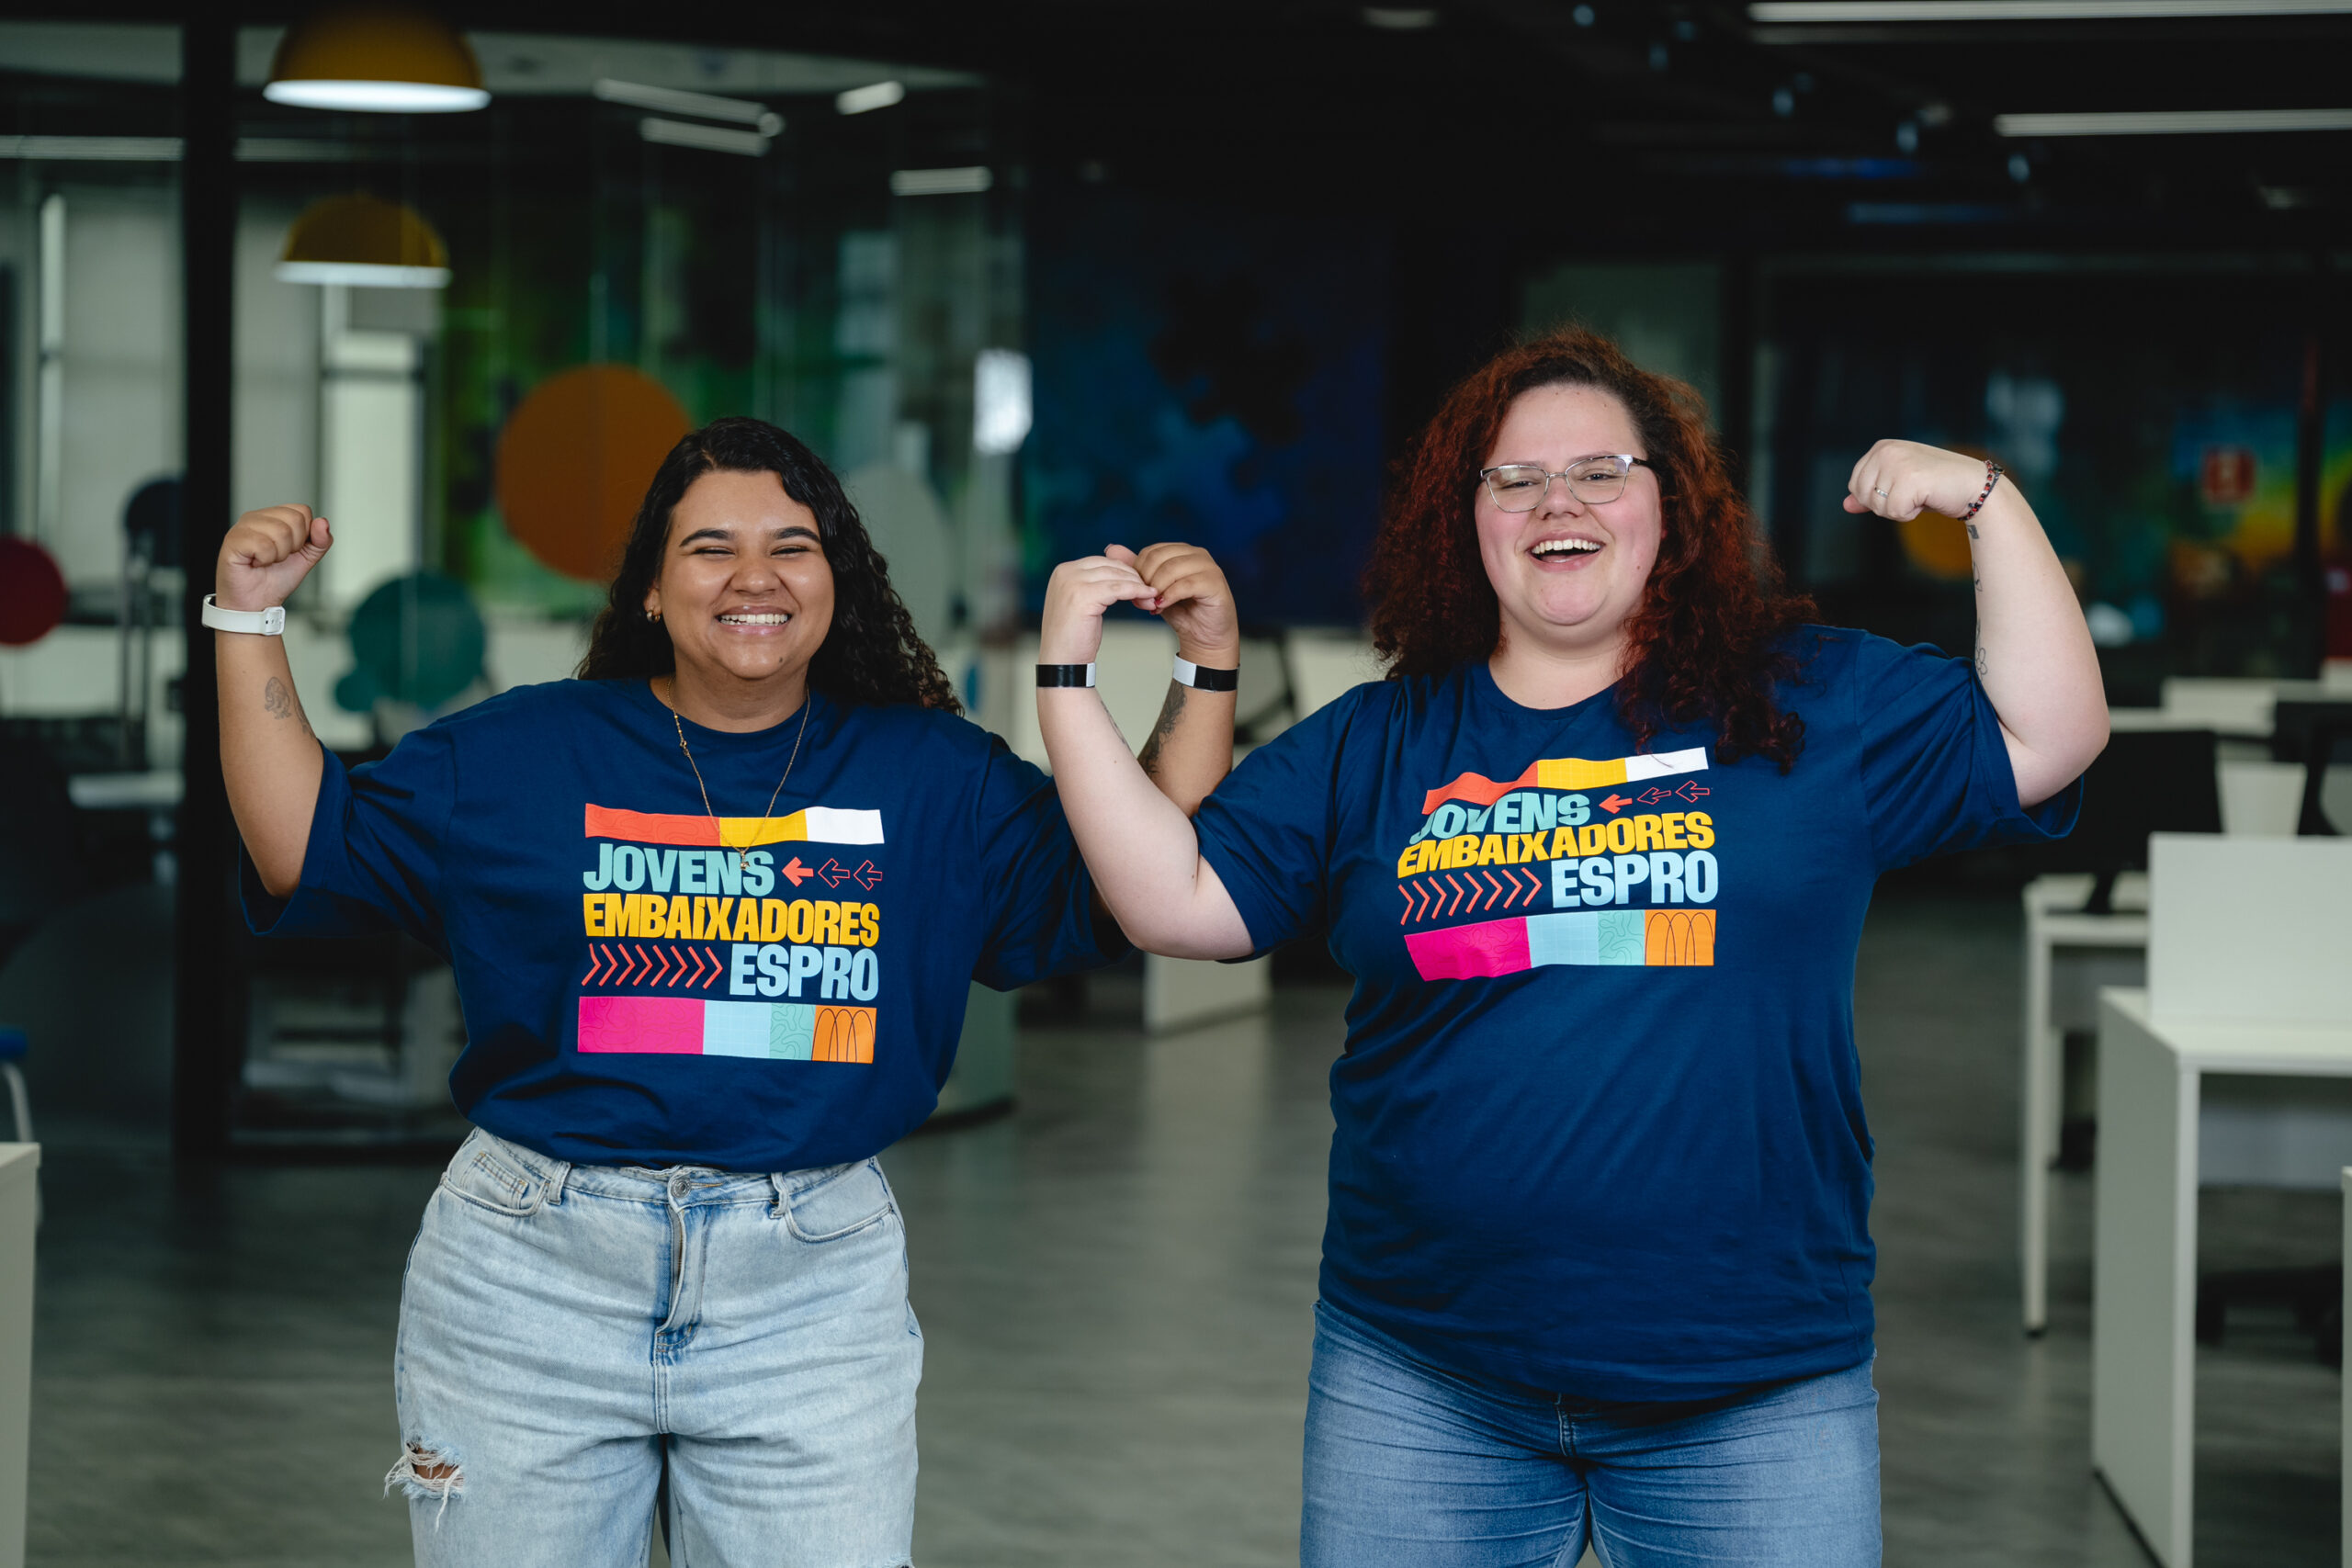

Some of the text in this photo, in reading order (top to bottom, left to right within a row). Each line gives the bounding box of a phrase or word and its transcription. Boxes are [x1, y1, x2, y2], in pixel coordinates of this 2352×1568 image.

[1397, 811, 1715, 878] EMBAIXADORES
[1408, 792, 1590, 845] JOVENS
[583, 843, 775, 897] JOVENS
[1551, 850, 1718, 908] ESPRO
[582, 893, 879, 947] EMBAIXADORES
[729, 943, 879, 1001] ESPRO
